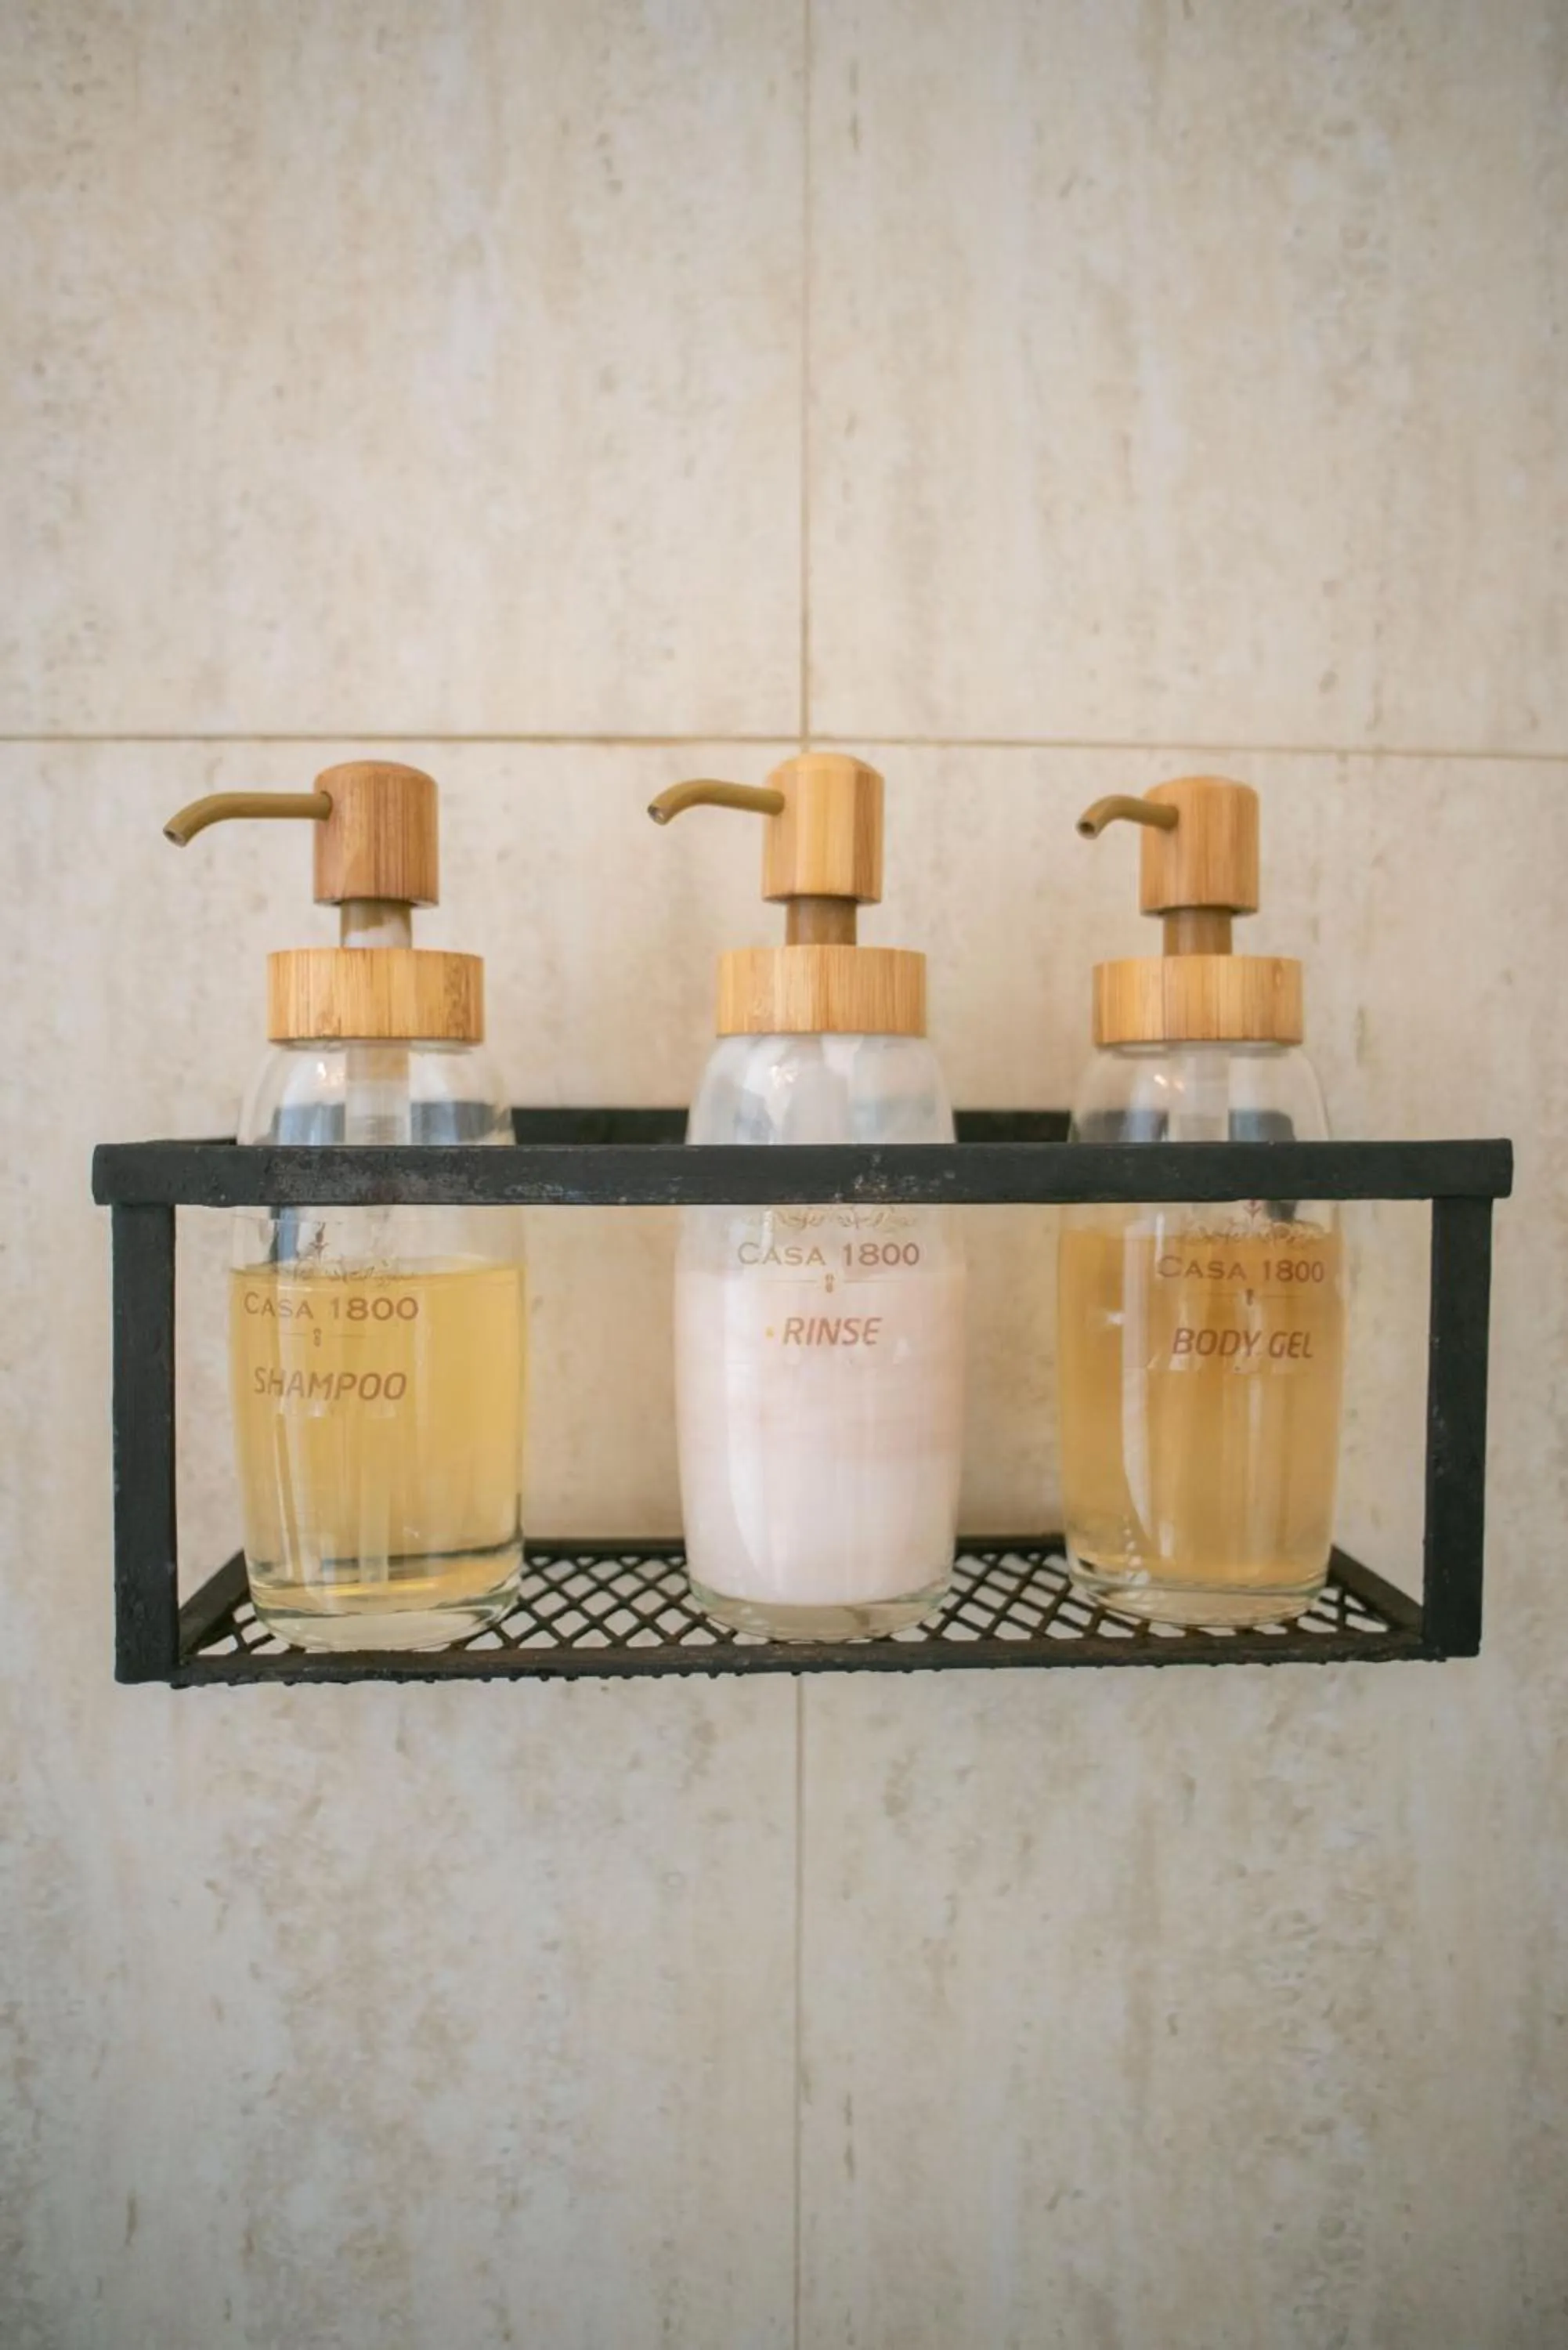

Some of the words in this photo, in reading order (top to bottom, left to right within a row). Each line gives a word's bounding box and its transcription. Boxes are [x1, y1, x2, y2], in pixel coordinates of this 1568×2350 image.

[737, 1242, 826, 1266] CASA
[843, 1242, 919, 1267] 1800
[1157, 1255, 1247, 1281] CASA
[1263, 1260, 1324, 1283] 1800
[244, 1292, 313, 1319] CASA
[330, 1297, 418, 1321] 1800
[782, 1317, 883, 1346] RINSE
[1172, 1328, 1261, 1358] BODY
[1268, 1332, 1313, 1358] GEL
[254, 1366, 407, 1401] SHAMPOO
